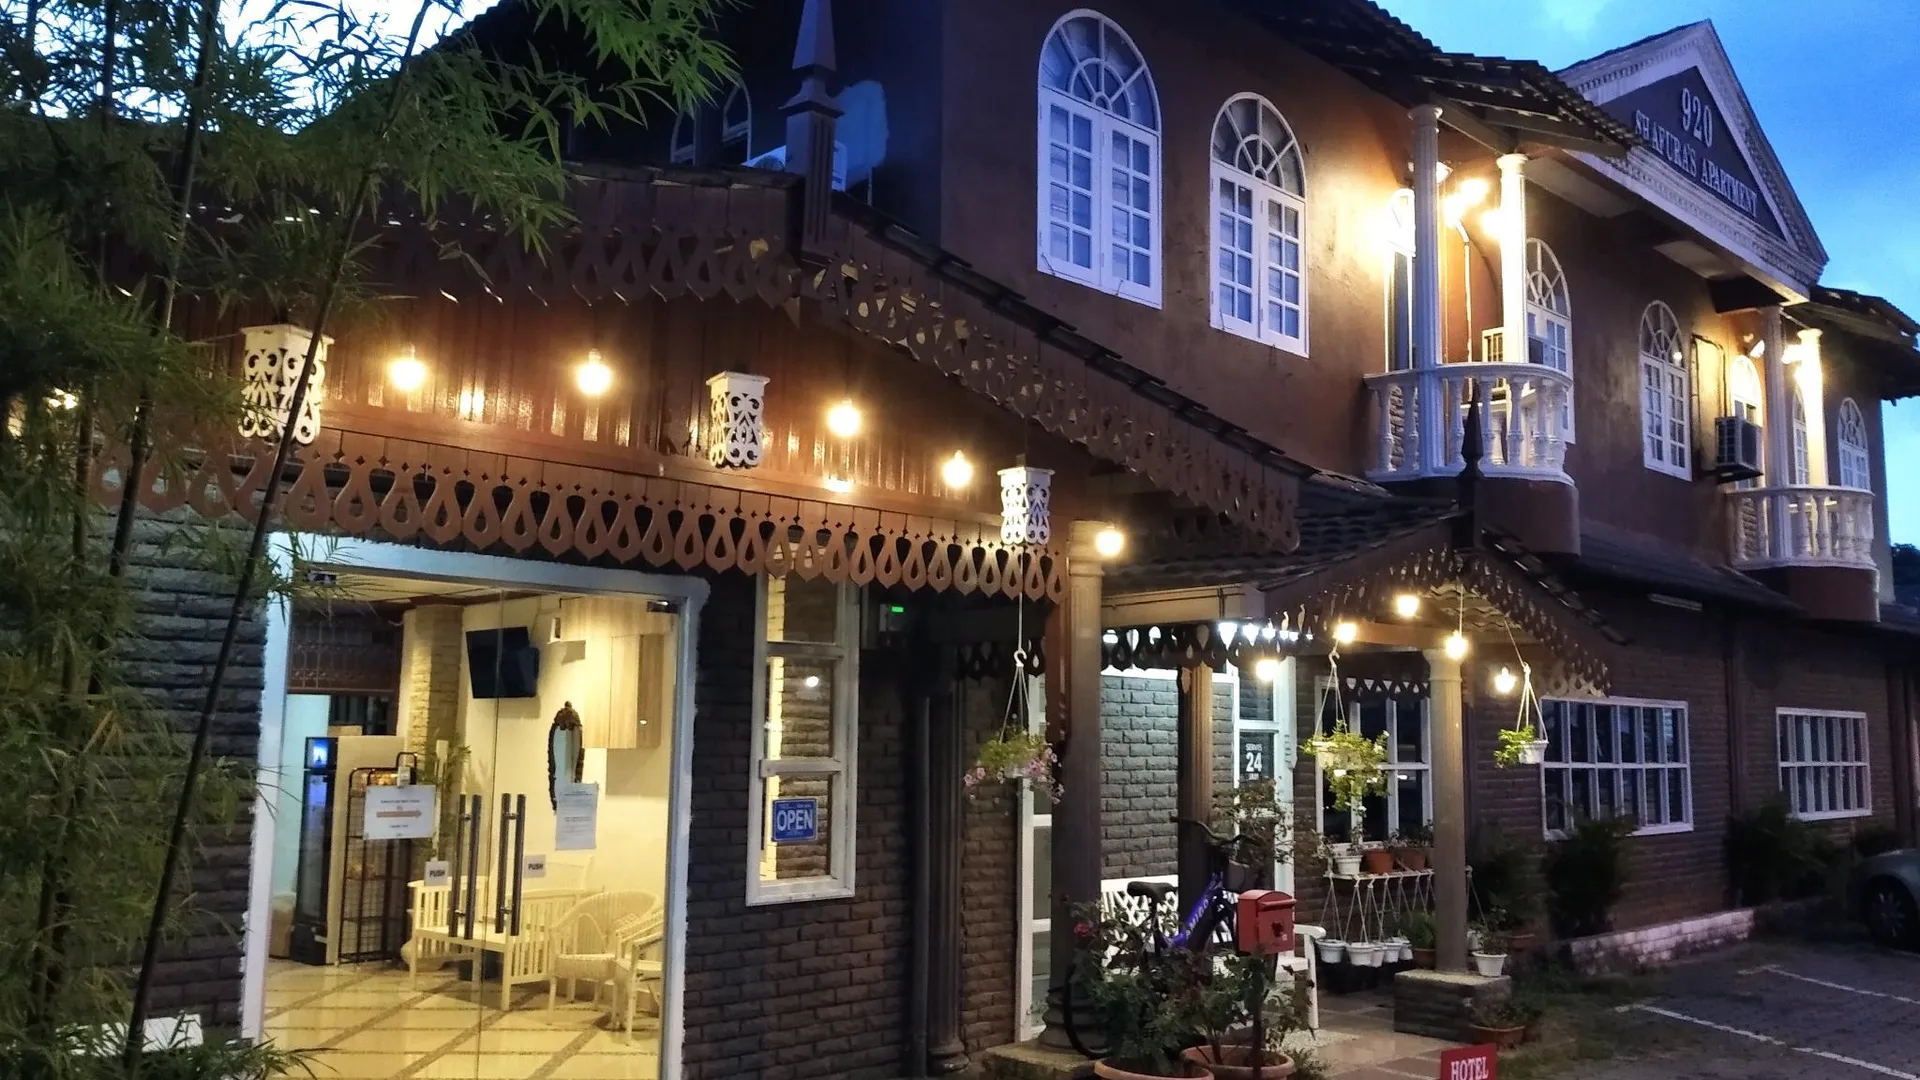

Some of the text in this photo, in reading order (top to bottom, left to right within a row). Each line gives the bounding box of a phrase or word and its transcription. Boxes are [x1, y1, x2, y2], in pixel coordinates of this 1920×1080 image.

[1682, 87, 1713, 148] 920
[1700, 158, 1757, 217] APARTMENT
[1245, 751, 1262, 772] 24
[776, 808, 813, 831] OPEN
[429, 869, 446, 878] PUSH
[1185, 898, 1209, 940] AMIGO
[1450, 1056, 1489, 1080] HOTEL
